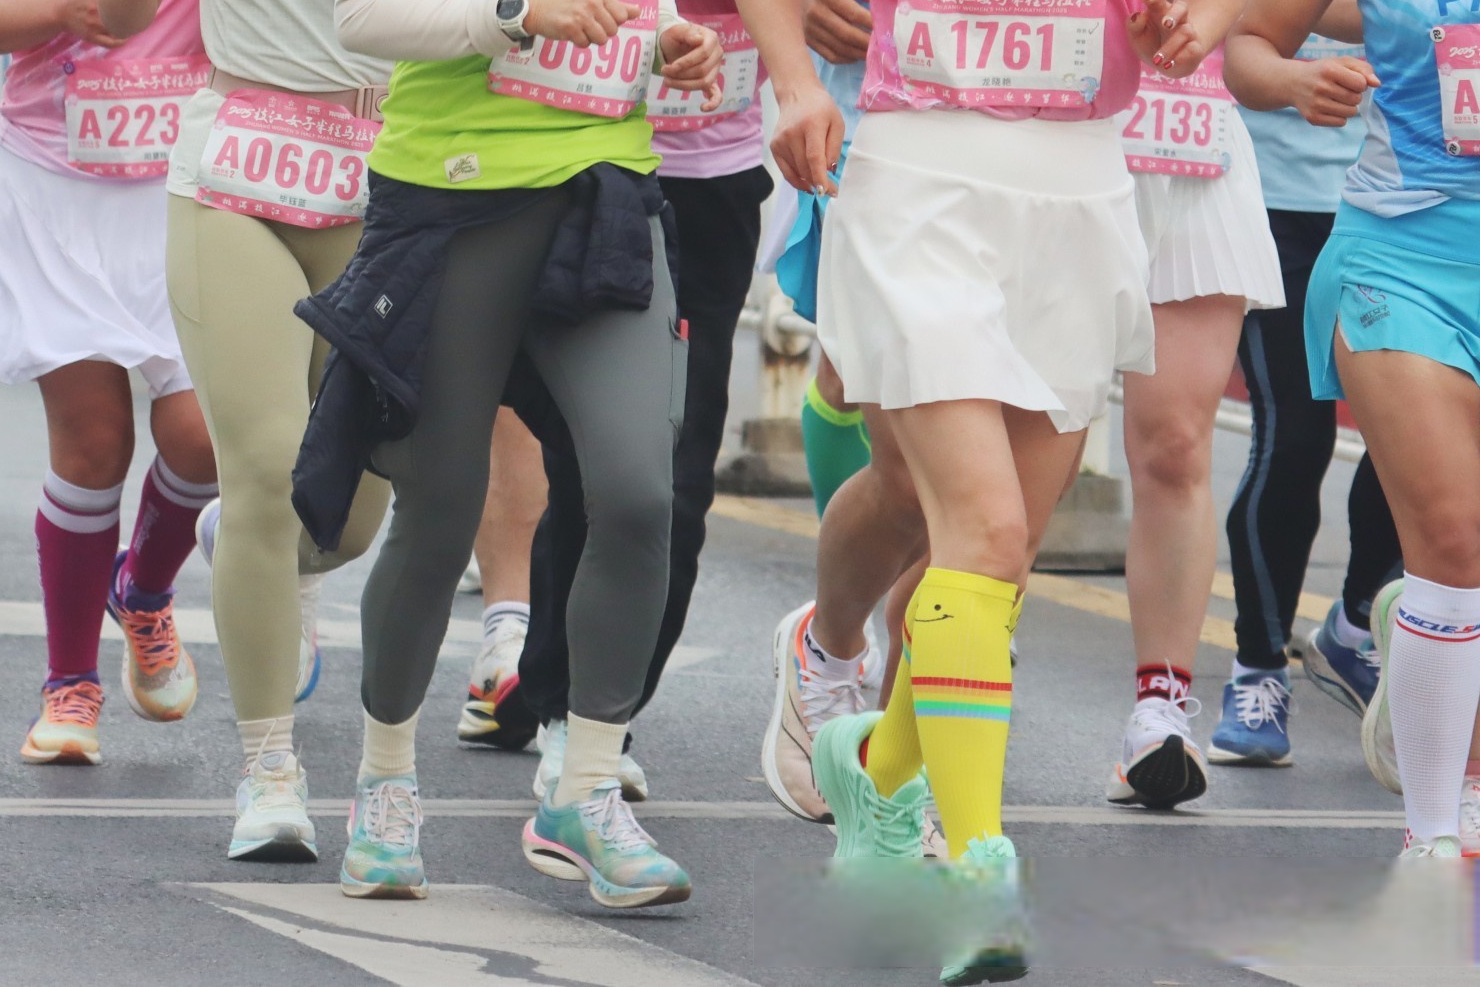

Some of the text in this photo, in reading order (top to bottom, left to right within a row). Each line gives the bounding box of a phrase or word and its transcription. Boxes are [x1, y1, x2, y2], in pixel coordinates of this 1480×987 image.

[539, 35, 642, 83] 0690
[907, 19, 1054, 71] A1761
[1122, 94, 1213, 147] 2133
[214, 135, 364, 201] A0603
